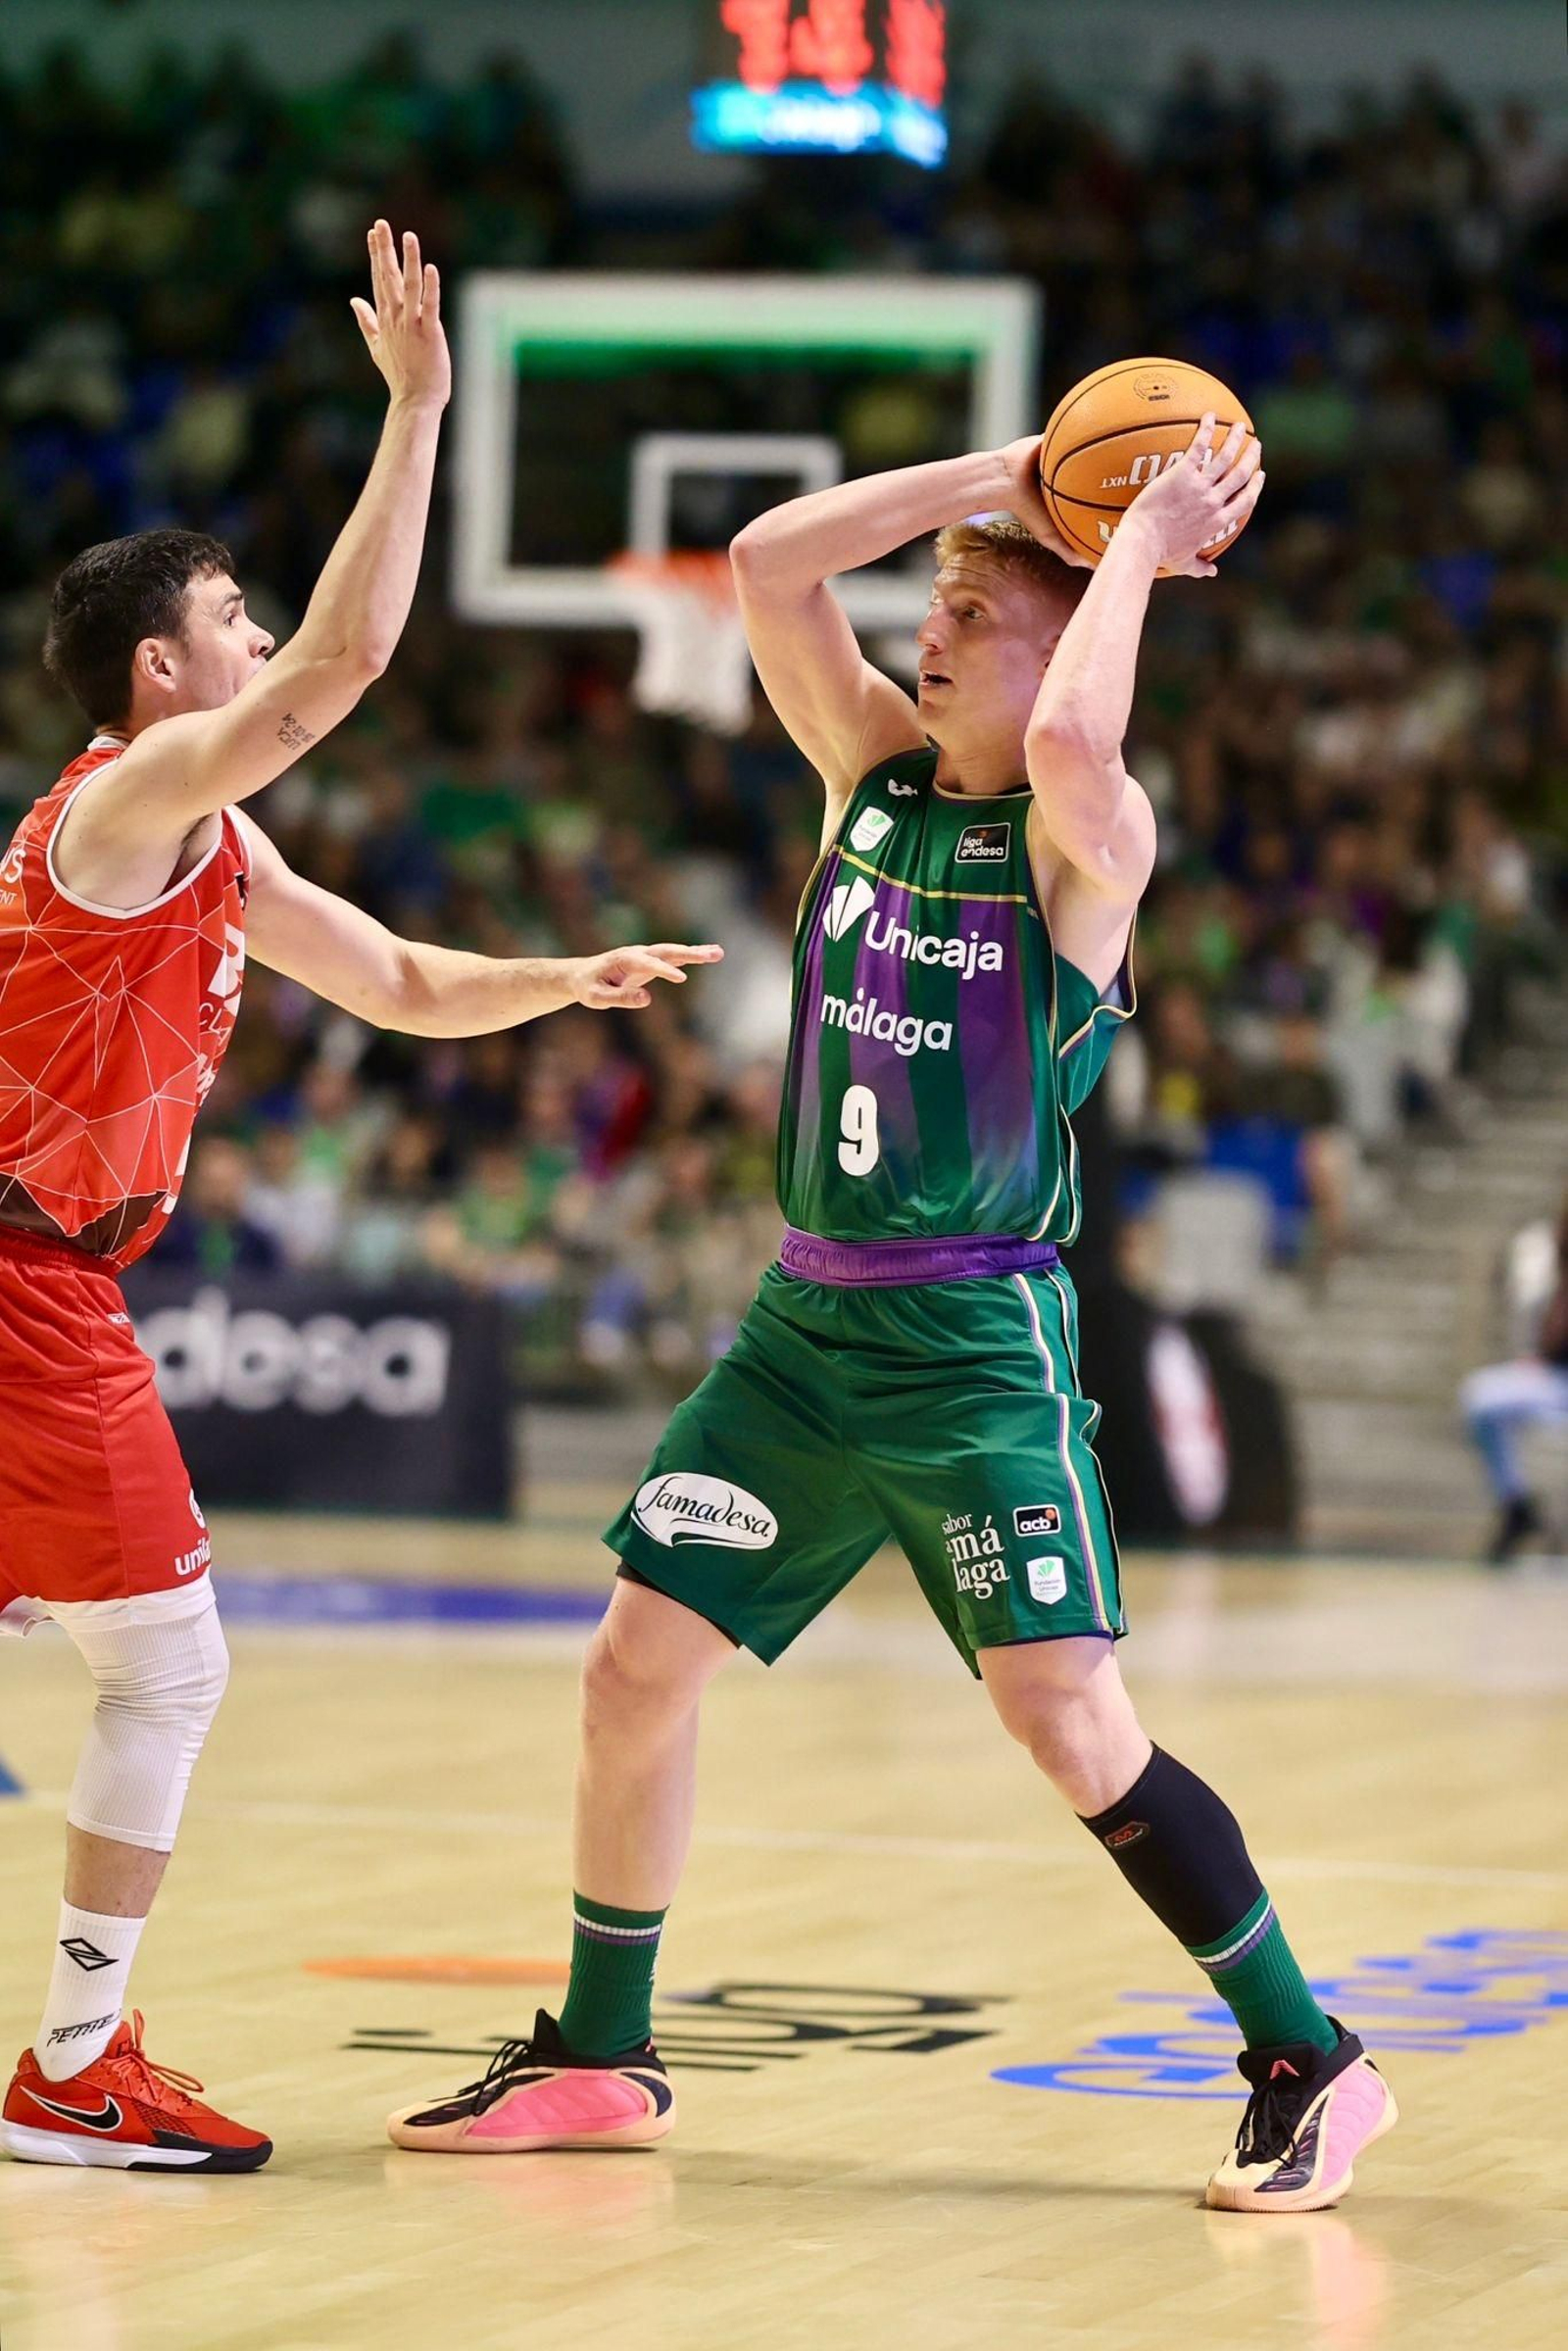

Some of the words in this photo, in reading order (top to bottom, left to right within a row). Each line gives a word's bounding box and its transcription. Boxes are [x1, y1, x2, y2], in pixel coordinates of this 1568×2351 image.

[1100, 475, 1127, 489] NXT
[960, 846, 1004, 857] endesa
[963, 836, 983, 848] liga
[864, 910, 1004, 980] Unicaja
[820, 987, 953, 1056] málaga
[838, 1085, 879, 1176] 9
[135, 1285, 454, 1419] desa
[942, 1513, 972, 1536] sabor
[1020, 1517, 1051, 1532] acb
